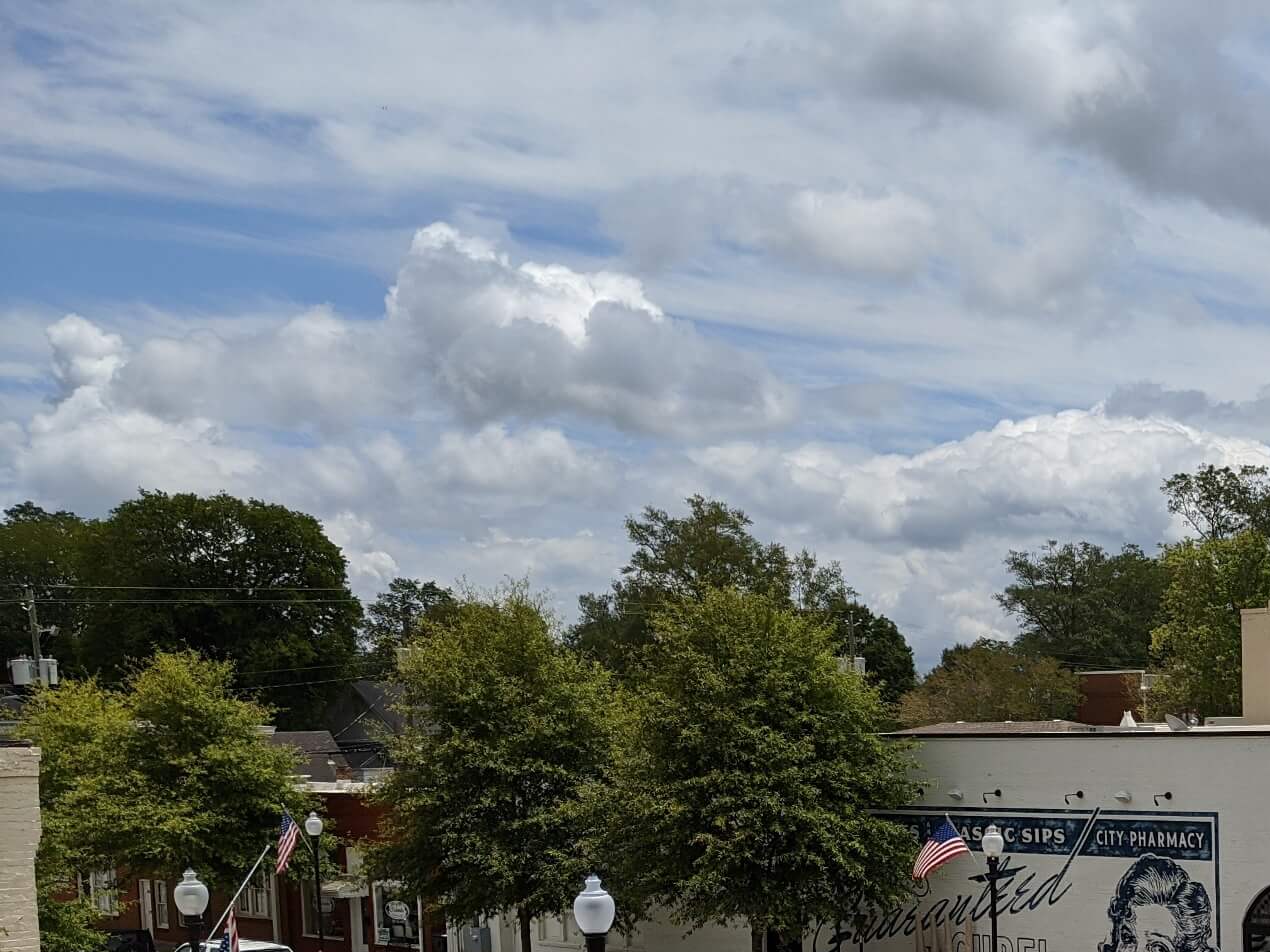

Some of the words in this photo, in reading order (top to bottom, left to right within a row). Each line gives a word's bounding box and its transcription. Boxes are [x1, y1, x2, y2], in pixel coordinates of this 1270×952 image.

[1021, 827, 1066, 844] SIPS
[1096, 829, 1125, 847] CITY
[1129, 830, 1205, 849] PHARMACY
